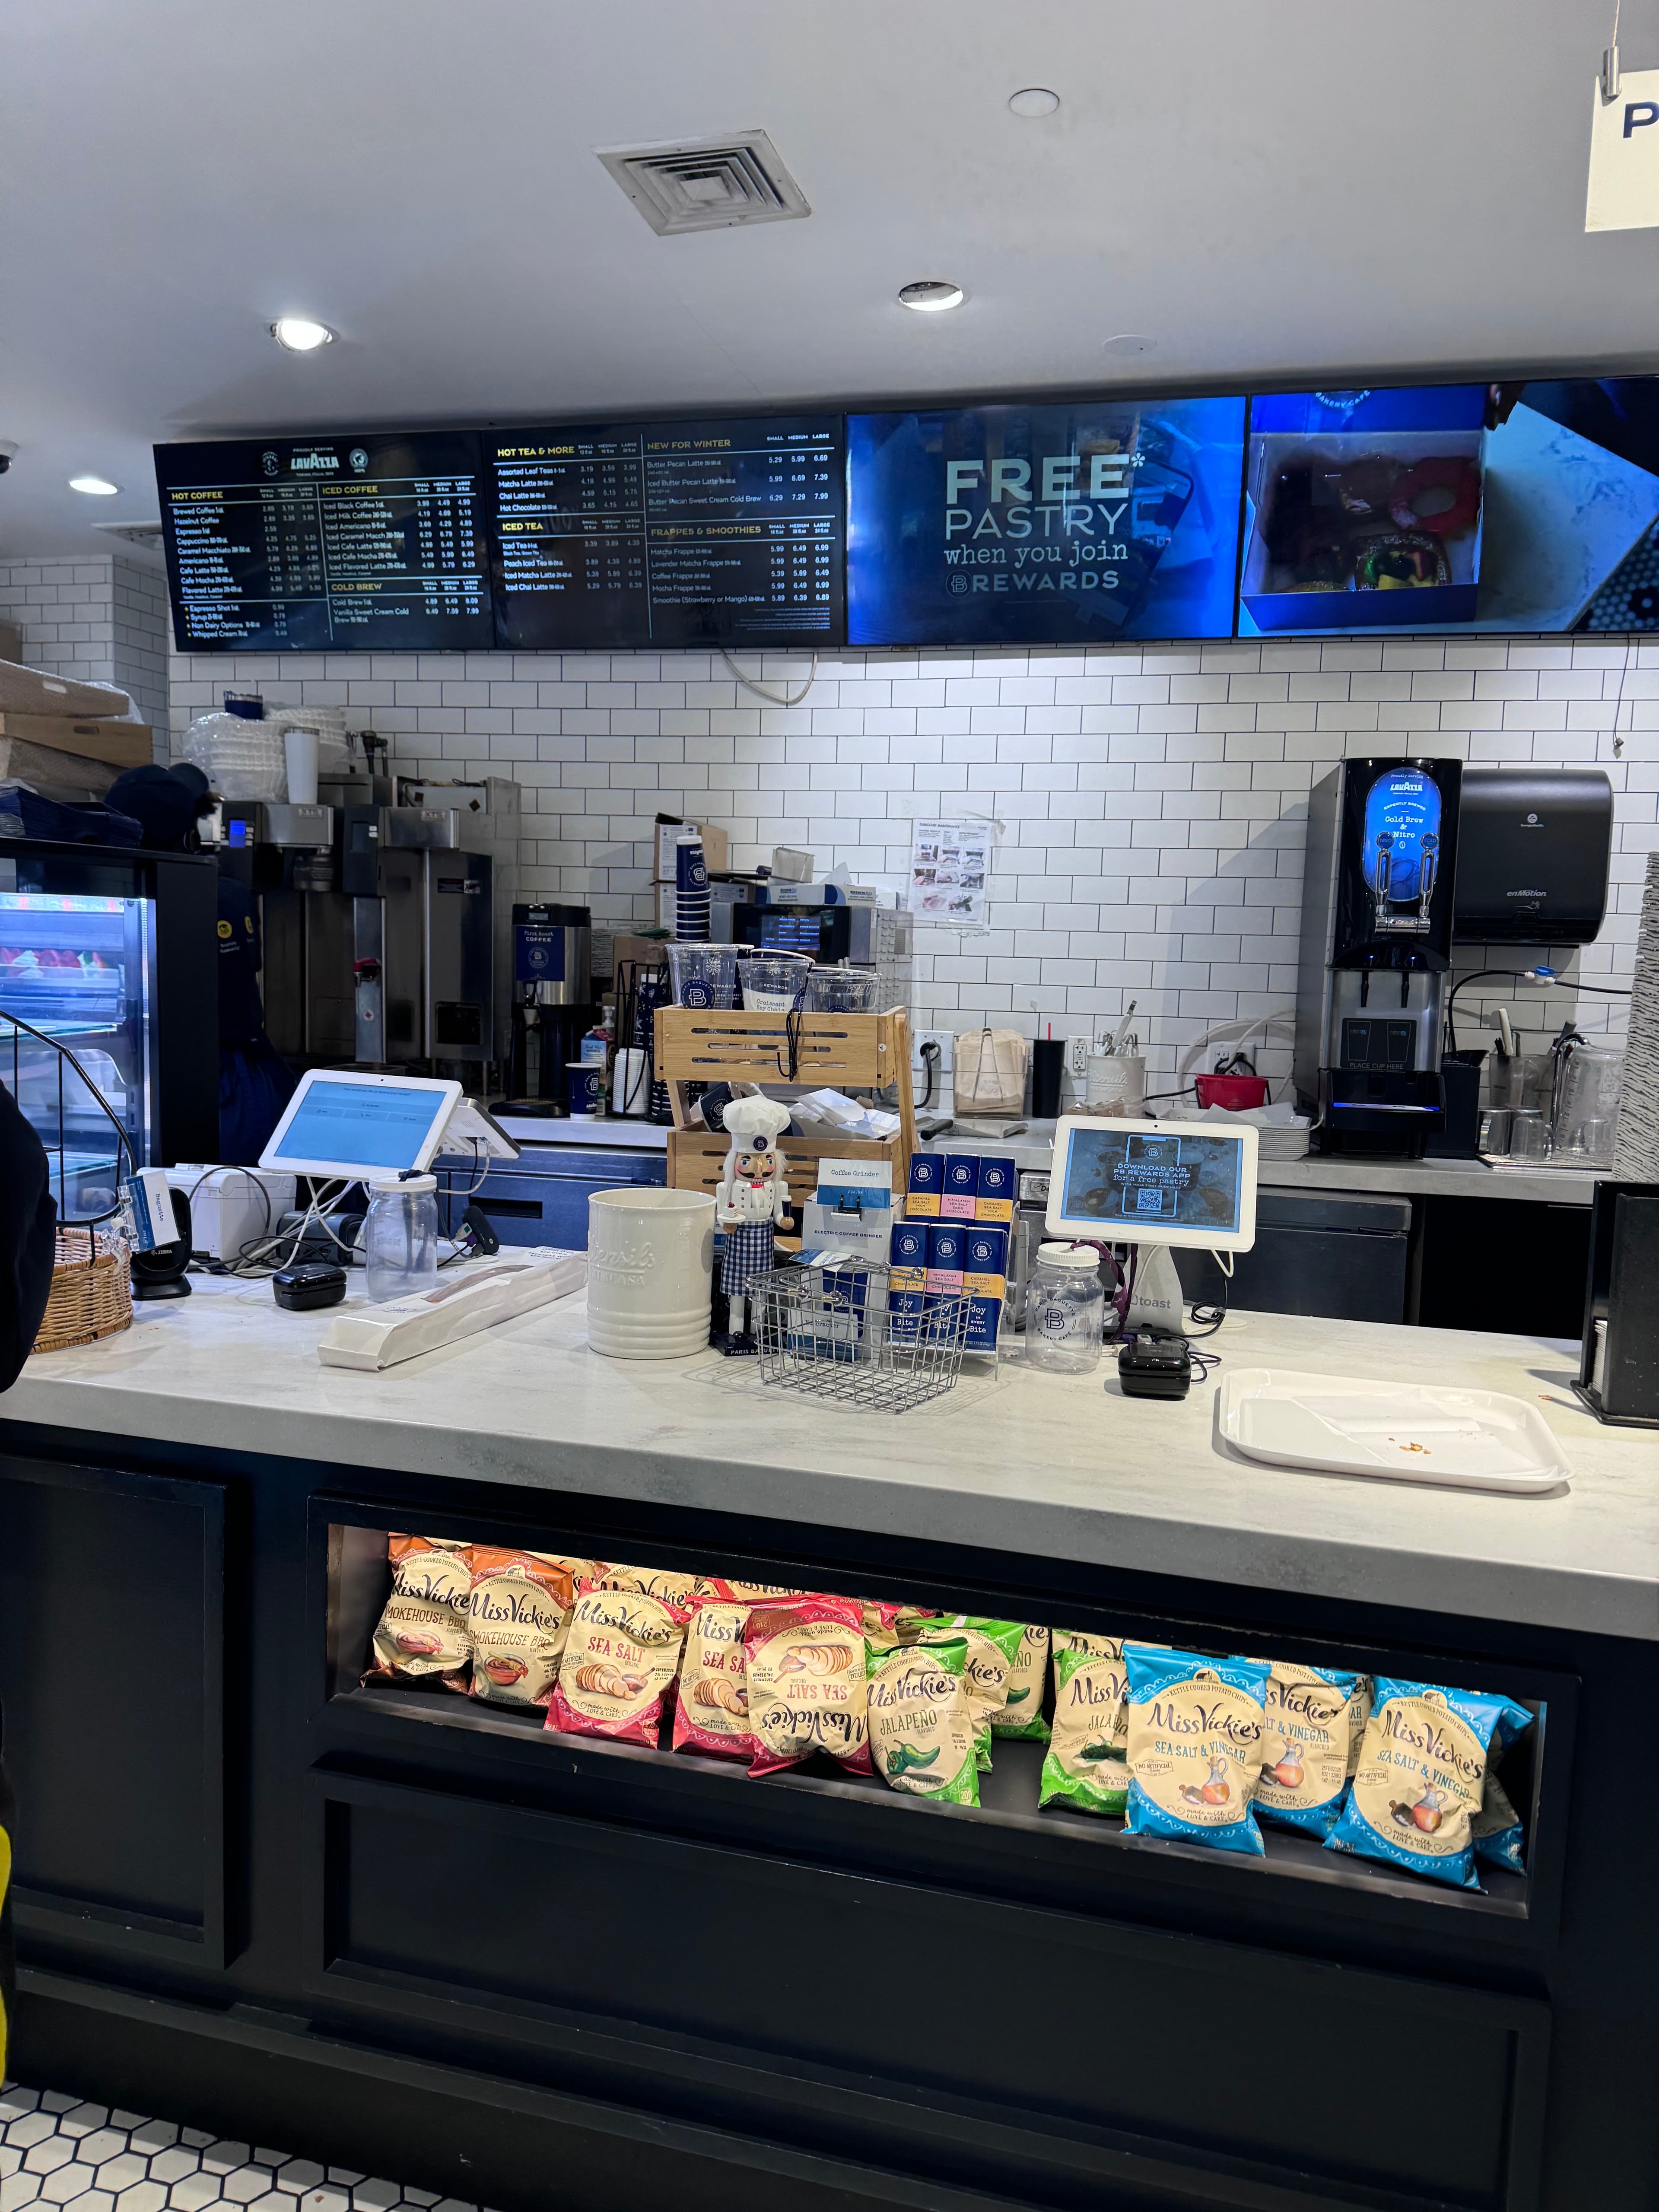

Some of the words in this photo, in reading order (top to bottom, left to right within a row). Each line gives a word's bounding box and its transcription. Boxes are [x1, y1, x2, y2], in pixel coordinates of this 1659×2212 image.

[693, 439, 731, 448] WINTER
[291, 453, 340, 470] LAVAZZA
[191, 491, 223, 499] COFFEE
[502, 523, 523, 531] ICED
[651, 528, 694, 536] FRAPPES
[706, 526, 761, 534] SMOOTHIES
[945, 503, 1128, 540] PASTRY
[944, 544, 1006, 565] when
[1015, 548, 1062, 569] you
[1069, 540, 1128, 566] join
[972, 570, 1119, 591] REWARDS
[1390, 782, 1422, 791] LAVAZZA
[972, 1306, 986, 1315] Joy
[1050, 1298, 1076, 1316] BAGUETTE
[1138, 1297, 1171, 1309] toast
[1037, 1328, 1057, 1341] BAKERY
[472, 1592, 510, 1621] Miss
[506, 1594, 562, 1635] Vickie's
[574, 1600, 618, 1627] Miss
[618, 1606, 672, 1647] Vickie's
[448, 1616, 467, 1632] BBQ
[470, 1630, 529, 1646] SMOKEHOUSE
[531, 1636, 550, 1650] BBQ
[588, 1636, 610, 1656] SEA
[616, 1642, 646, 1662] SALT
[702, 1650, 725, 1670] SEA
[787, 1684, 817, 1699] SALT
[823, 1684, 847, 1700] SEA
[867, 1684, 896, 1708] Miss
[897, 1668, 956, 1703] Vickie's
[1070, 1677, 1111, 1707] Miss
[1170, 1685, 1189, 1697] KETTLE
[1211, 1685, 1231, 1696] POTATO
[1232, 1692, 1246, 1704] CHIPS
[762, 1702, 828, 1743] Vickie's
[823, 1710, 867, 1742] Miss
[880, 1708, 938, 1736] JALAPEÑO
[1147, 1703, 1200, 1735] Miss
[1194, 1702, 1262, 1745] Vickie's
[1278, 1724, 1286, 1735] &
[1288, 1723, 1329, 1742] VINEGAR
[1155, 1741, 1172, 1754] SEA
[1176, 1746, 1198, 1758] SALT
[1201, 1746, 1208, 1757] &
[1210, 1742, 1246, 1764] VINEGAR
[1382, 1710, 1425, 1748] Miss
[1421, 1722, 1484, 1783] Vickie's
[1377, 1750, 1392, 1763] SEA
[1394, 1752, 1419, 1771] SALT
[1421, 1764, 1429, 1779] &
[1433, 1768, 1471, 1799] VINEGAR
[960, 1790, 972, 1800] 200
